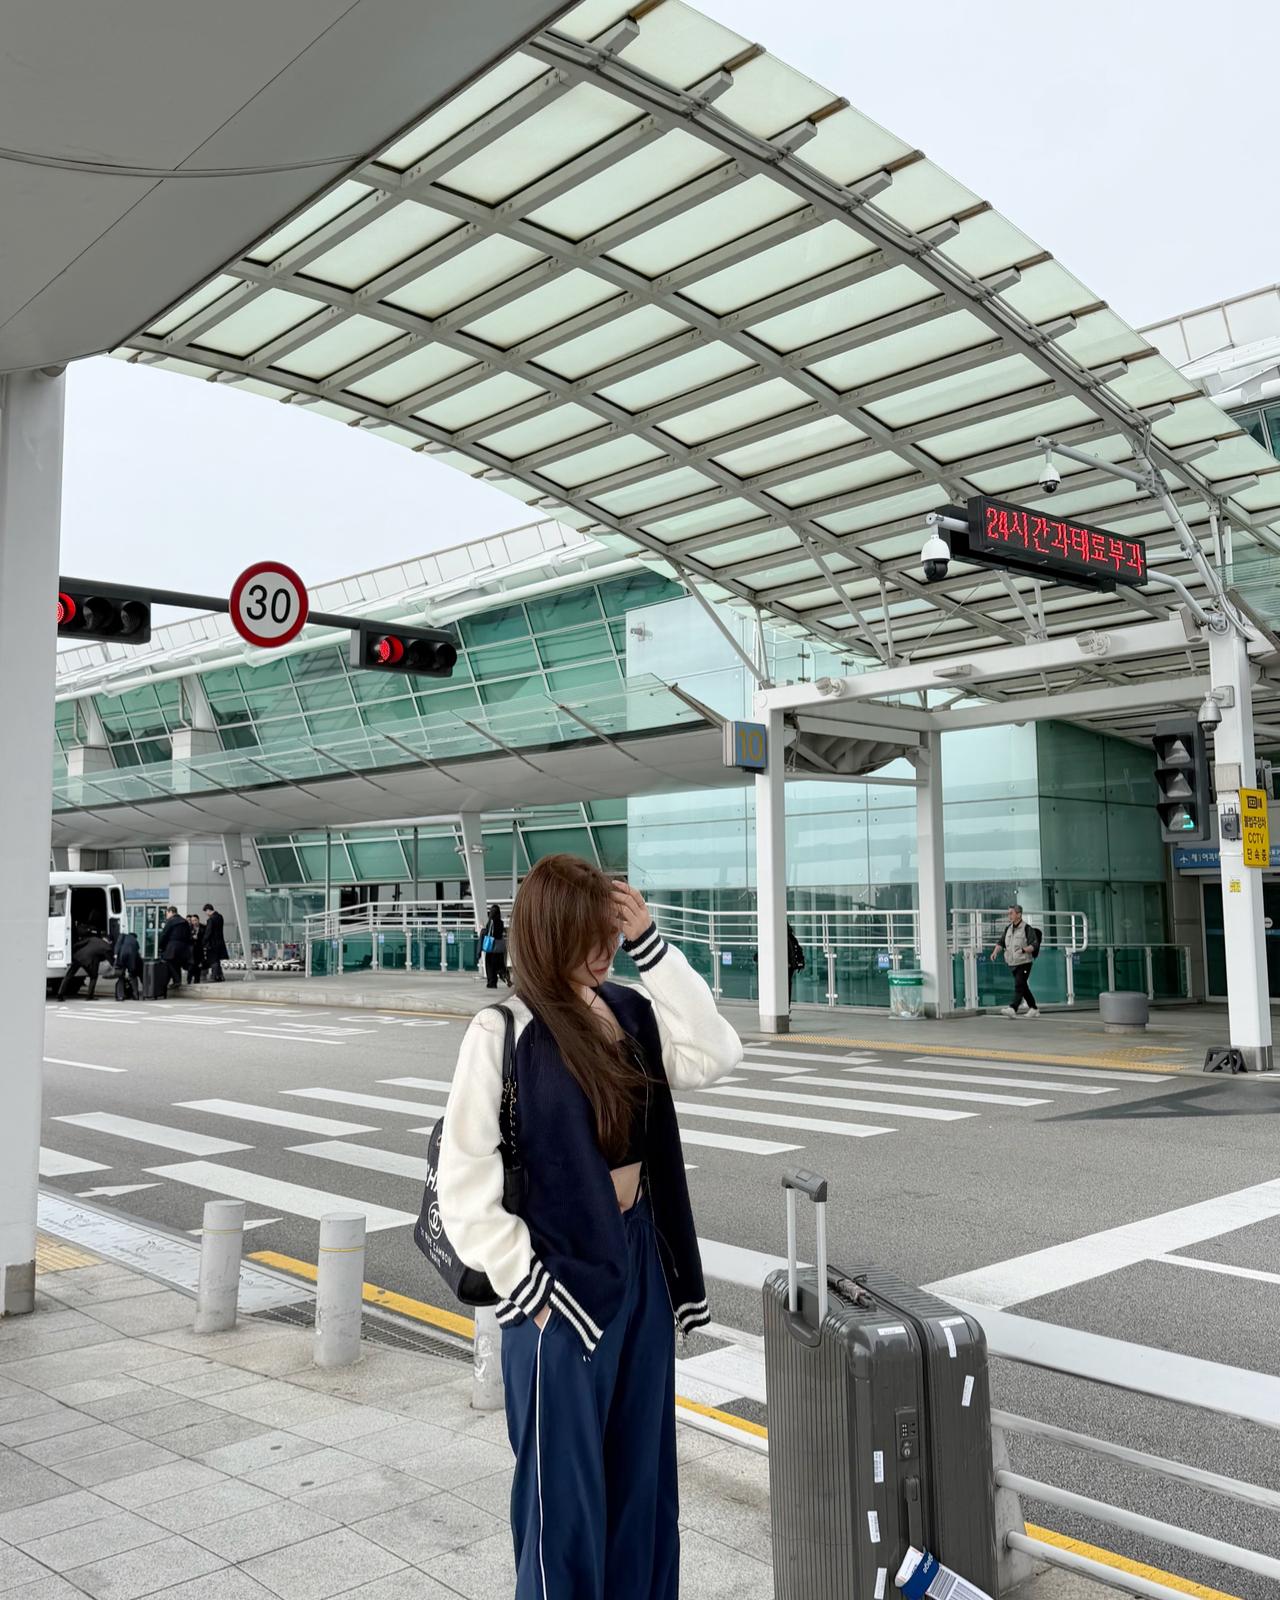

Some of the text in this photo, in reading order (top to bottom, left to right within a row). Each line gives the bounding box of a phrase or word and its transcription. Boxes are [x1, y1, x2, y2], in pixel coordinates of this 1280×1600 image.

[246, 584, 291, 624] 30
[738, 729, 764, 762] 10
[1248, 832, 1264, 844] CCTV
